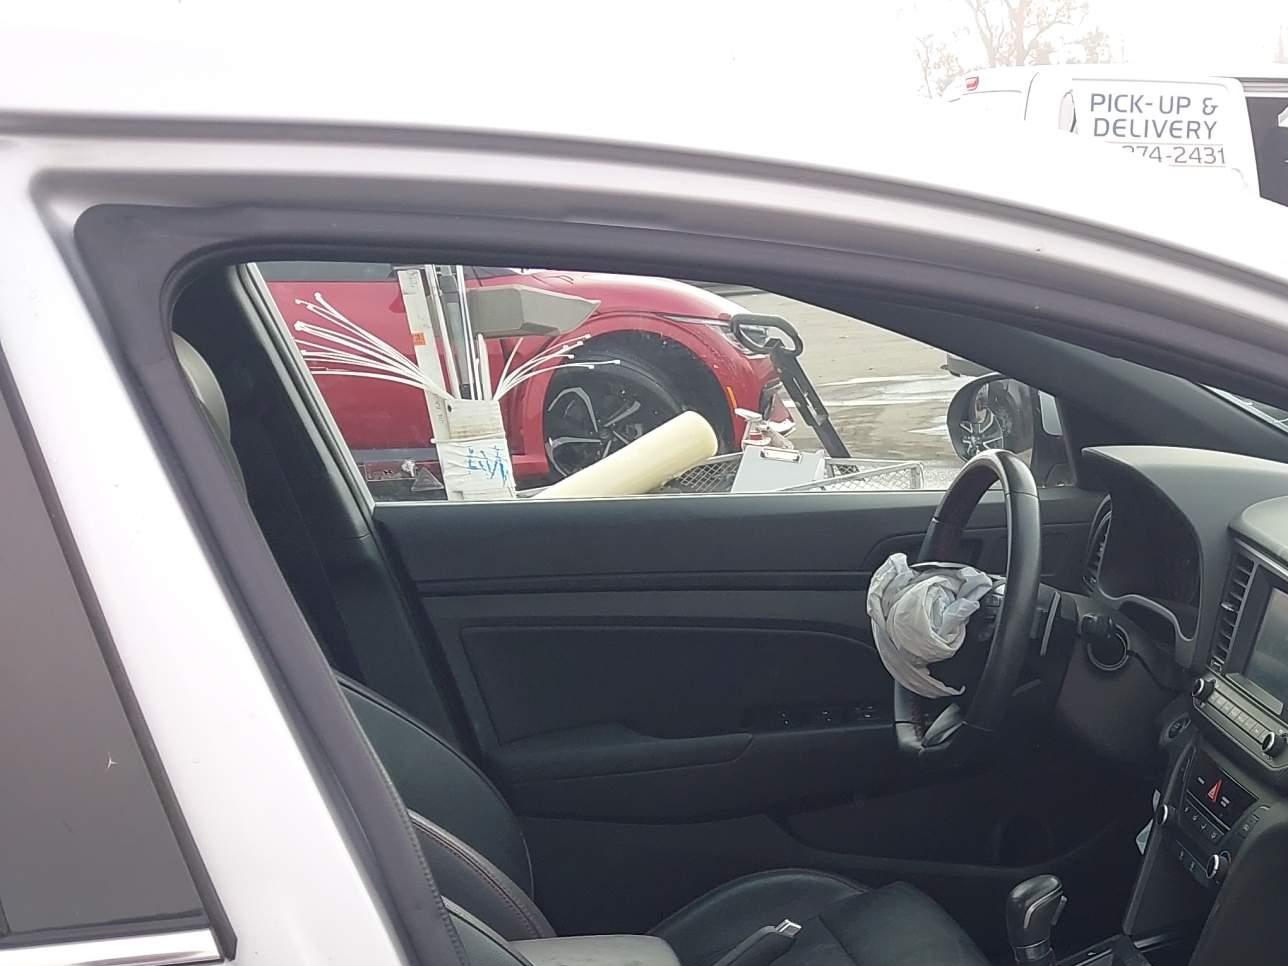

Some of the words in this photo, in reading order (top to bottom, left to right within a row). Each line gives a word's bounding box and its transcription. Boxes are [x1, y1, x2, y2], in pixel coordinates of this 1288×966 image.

[1090, 93, 1191, 115] PICK-UP
[1202, 97, 1218, 116] &
[1093, 117, 1217, 140] DELIVERY
